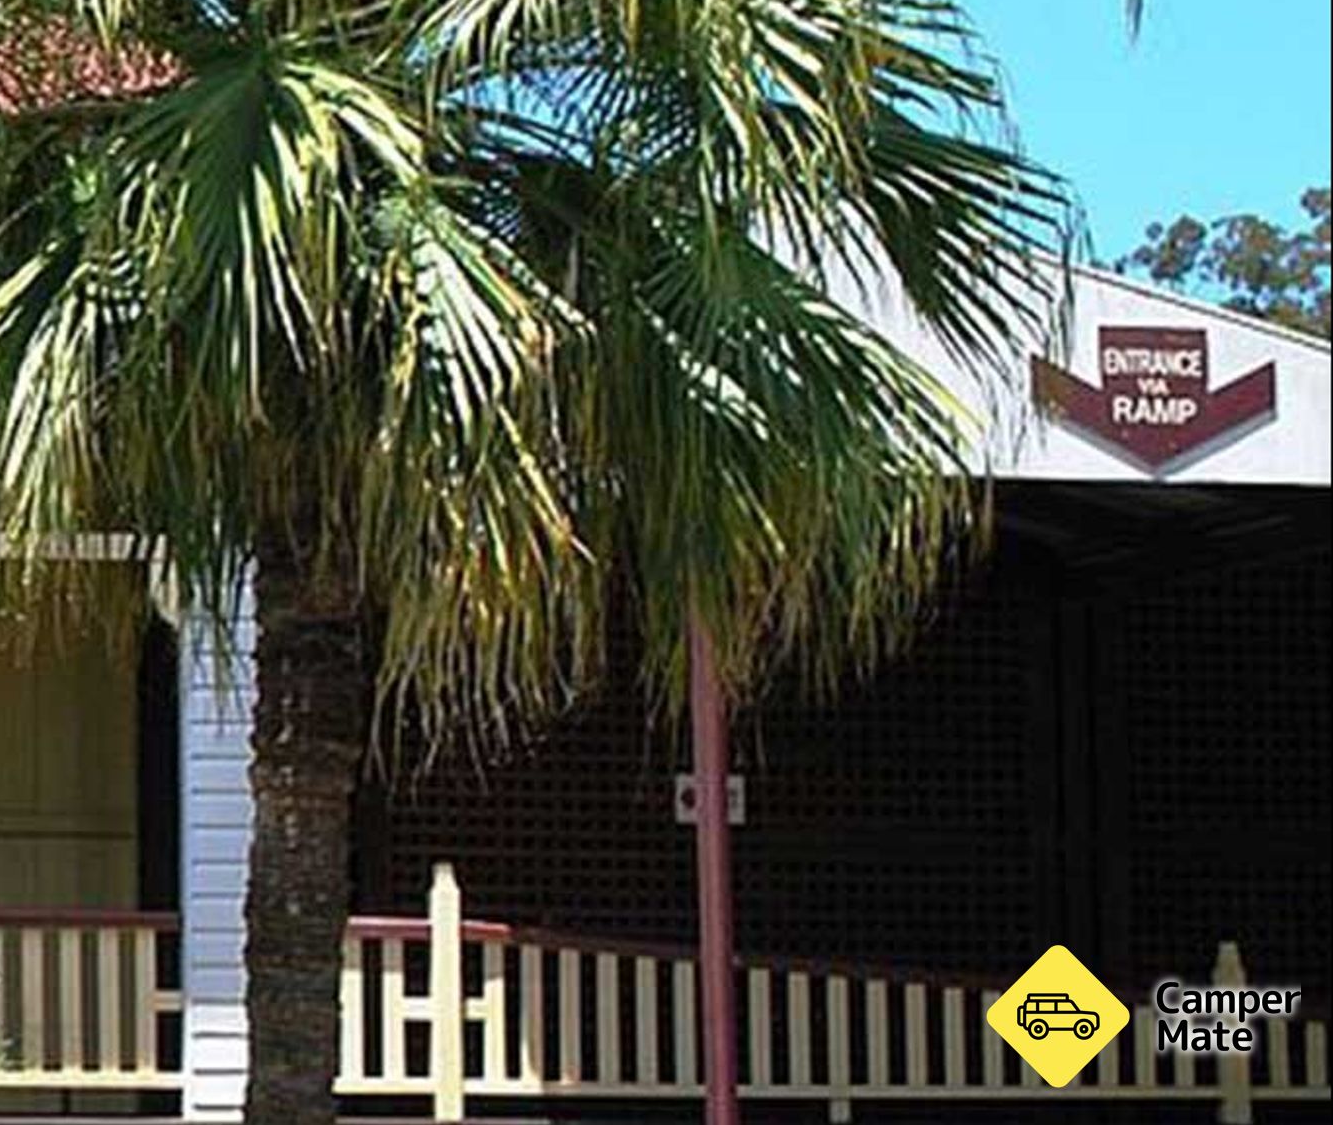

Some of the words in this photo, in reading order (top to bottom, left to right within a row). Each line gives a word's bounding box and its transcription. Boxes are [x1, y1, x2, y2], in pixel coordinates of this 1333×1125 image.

[1103, 347, 1203, 377] ENTRANCE
[1137, 378, 1170, 396] VIA
[1112, 396, 1198, 424] RAMP
